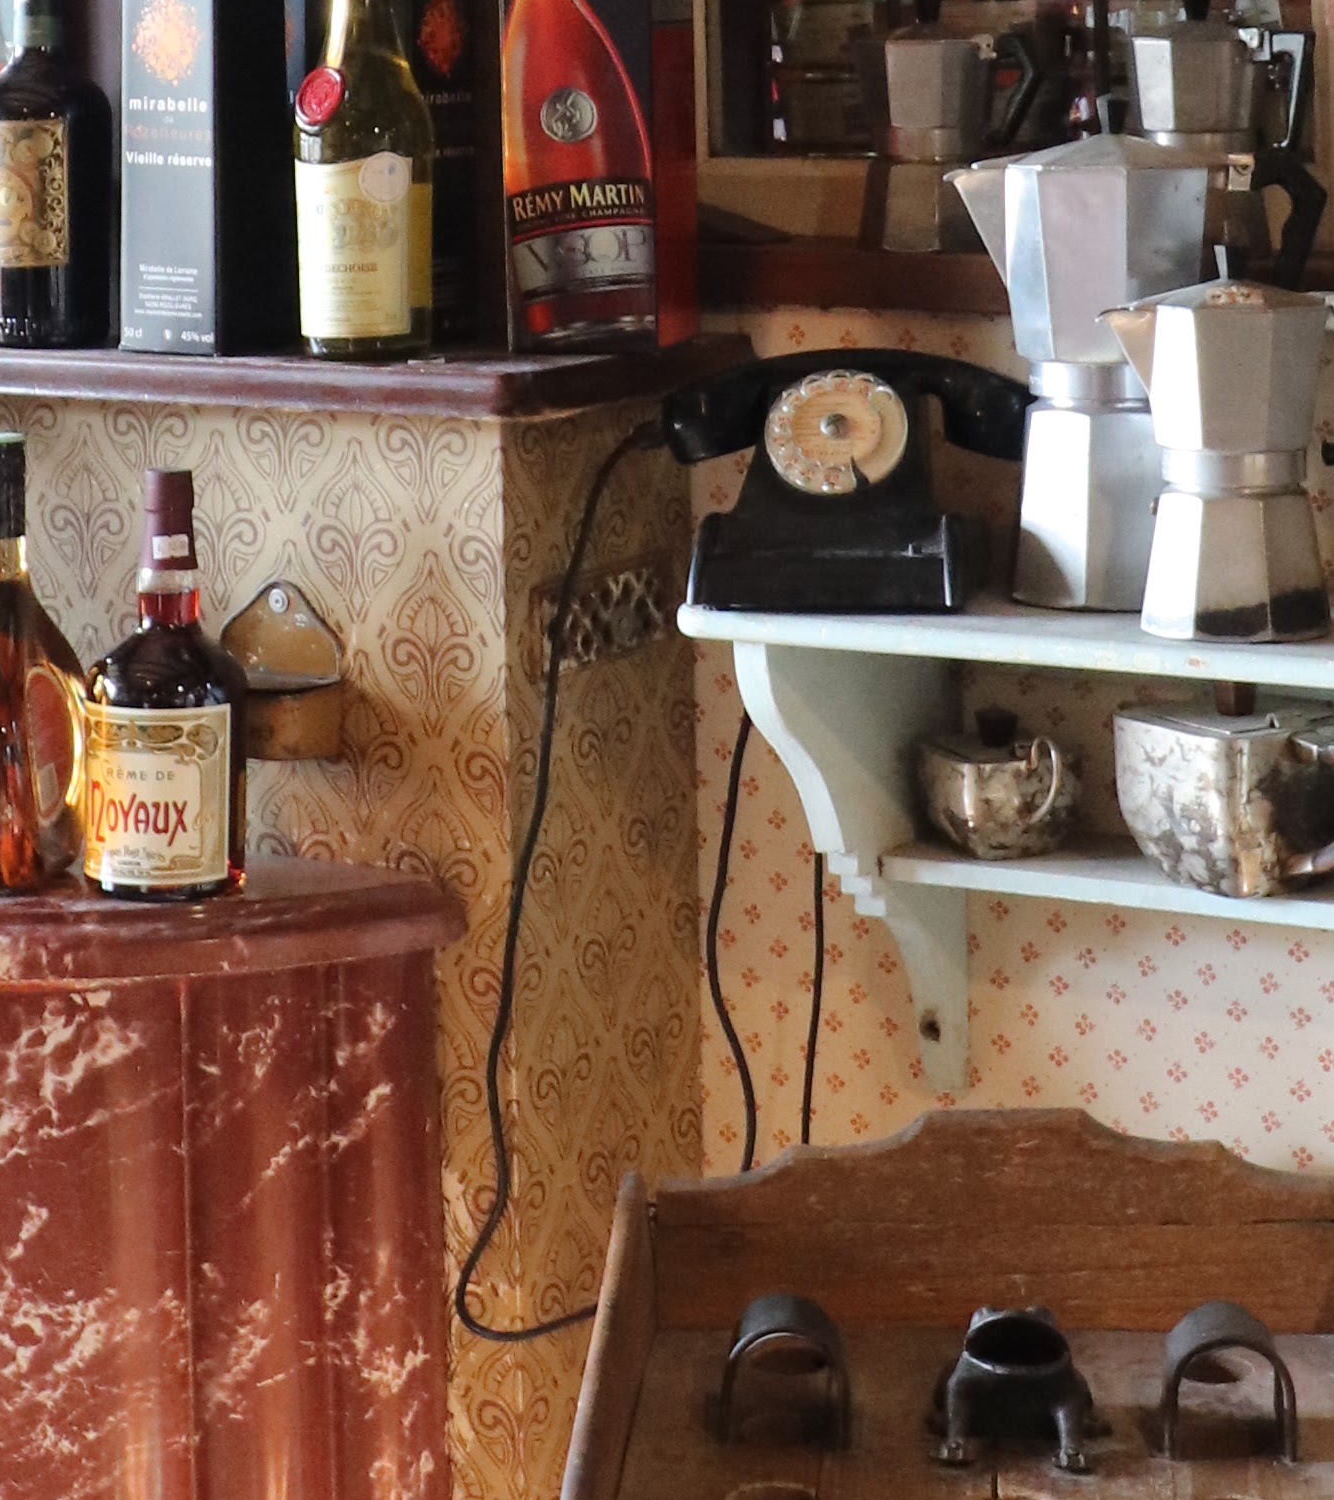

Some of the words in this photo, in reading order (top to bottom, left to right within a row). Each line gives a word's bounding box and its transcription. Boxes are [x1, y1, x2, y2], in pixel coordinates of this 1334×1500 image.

[129, 96, 208, 113] mirabelle
[125, 150, 165, 166] Vieille
[167, 152, 213, 168] réserve
[512, 189, 564, 223] RÉMY
[568, 182, 645, 209] MARTIN
[180, 330, 200, 343] 45%
[200, 332, 215, 344] vol
[155, 769, 176, 781] DE
[90, 779, 188, 847] NOYAUX
